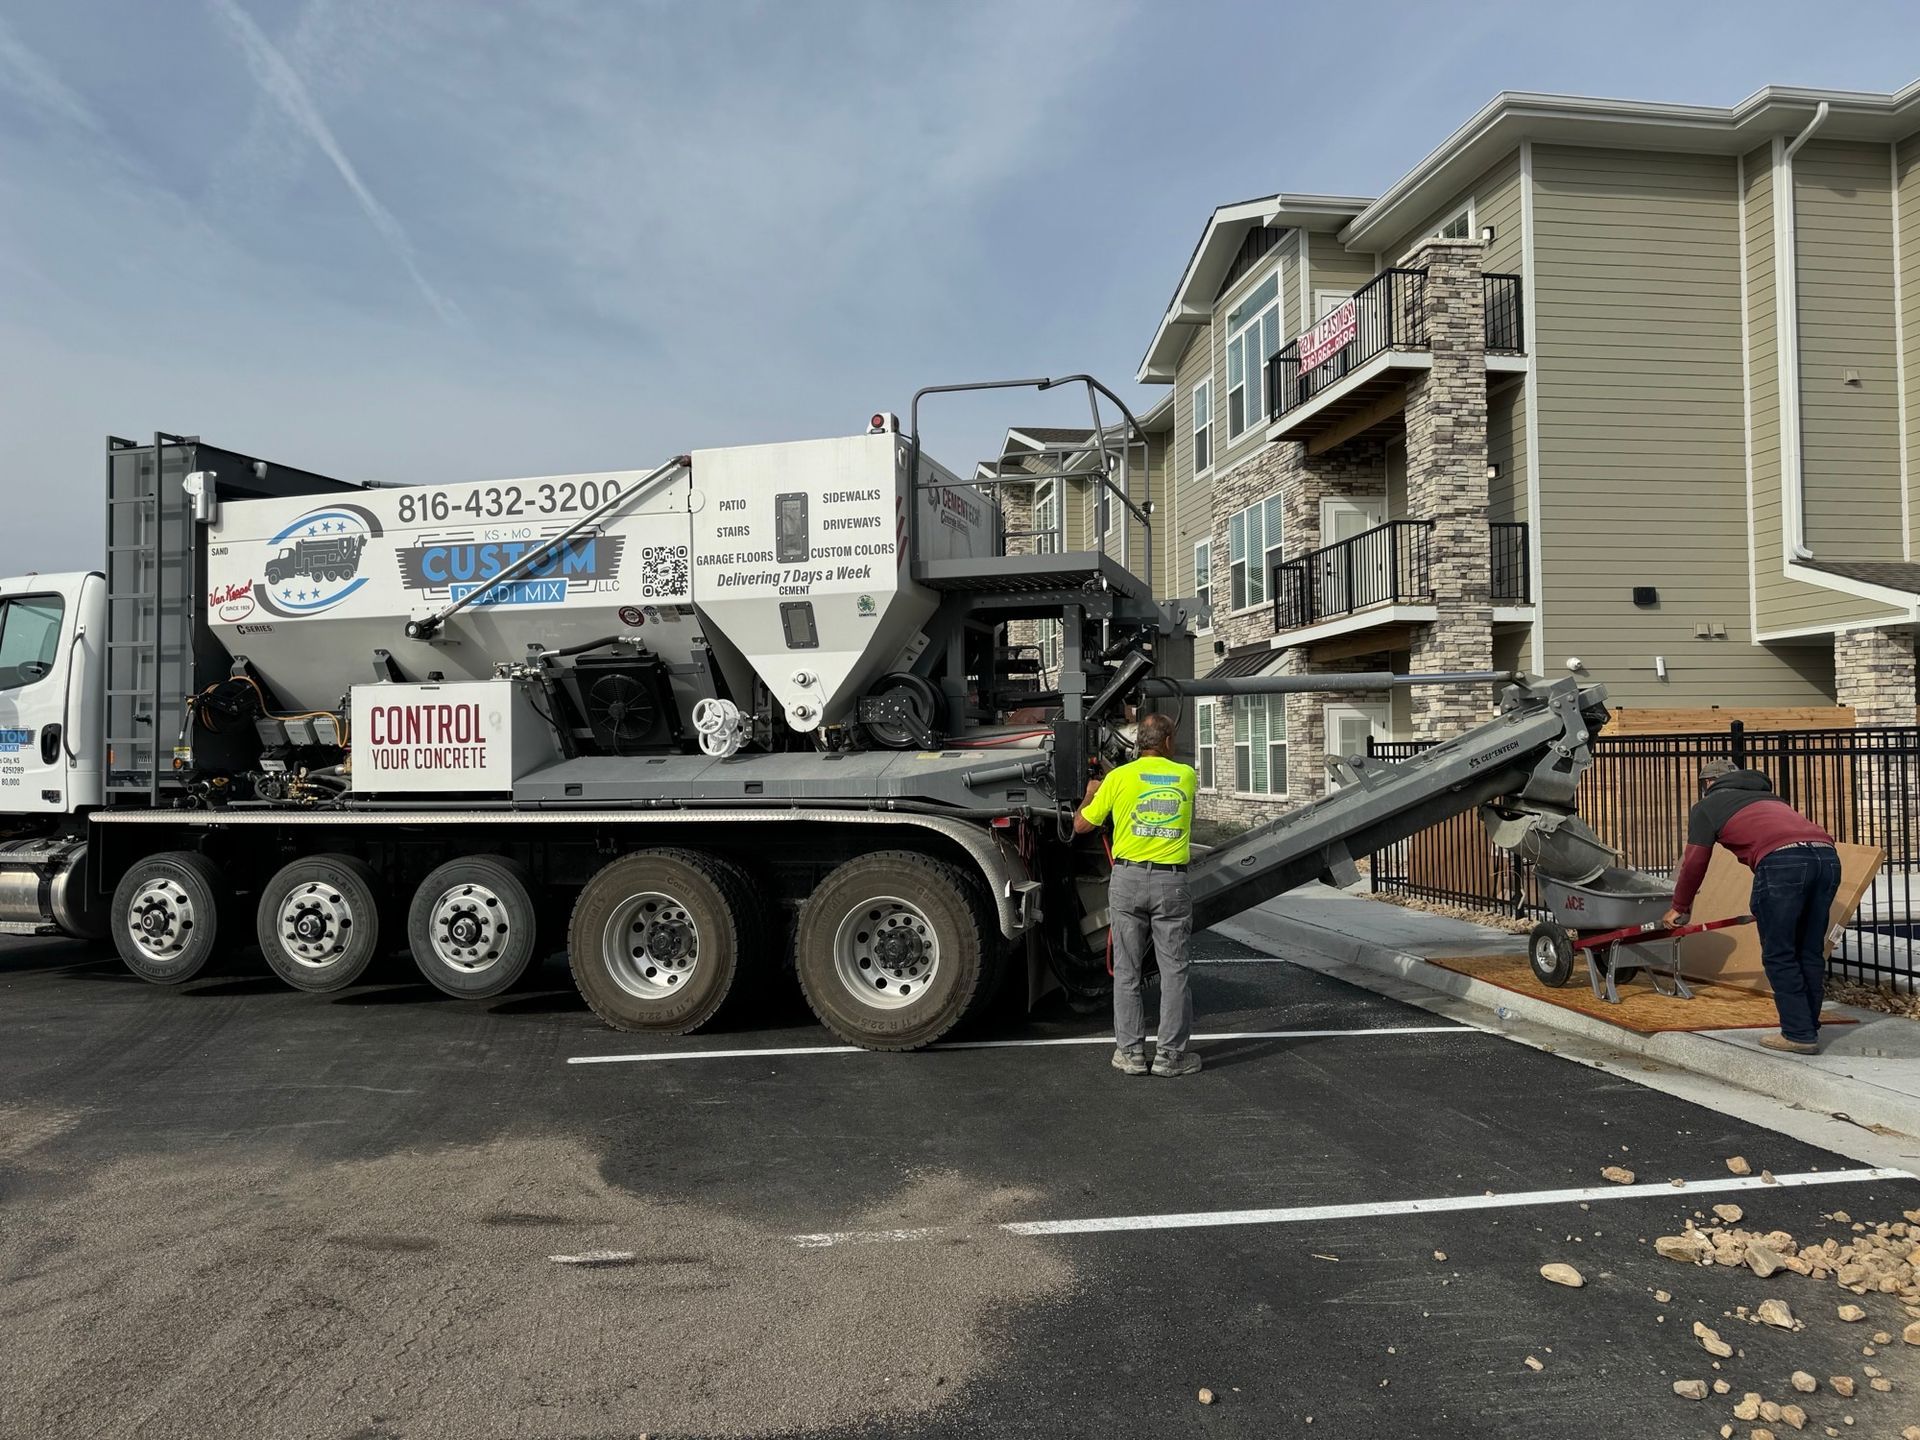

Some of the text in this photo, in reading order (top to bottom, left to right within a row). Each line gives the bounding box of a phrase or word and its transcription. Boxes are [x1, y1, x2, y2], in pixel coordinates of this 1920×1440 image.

[399, 480, 621, 523] 816-432-3200
[822, 489, 881, 503] SIDEWALKS
[720, 499, 746, 511] PATIO
[823, 516, 881, 530] DRIVEWAYS
[484, 528, 531, 541] KS MO
[717, 525, 750, 538] STAIRS
[211, 547, 229, 556] SAND
[696, 551, 774, 566] GARAGE FLOORS
[811, 543, 895, 559] CUSTOM COLORS
[422, 539, 596, 582] CUSTOM
[717, 564, 871, 587] Delivering 7 Days a Week
[525, 583, 561, 601] MIX
[598, 580, 620, 592] LLC
[778, 585, 810, 596] CEMENT
[209, 586, 225, 607] Van
[236, 624, 246, 635] C
[371, 704, 487, 745] CONTROL
[372, 747, 487, 770] YOUR CONCRETE
[1565, 895, 1585, 911] ACE
